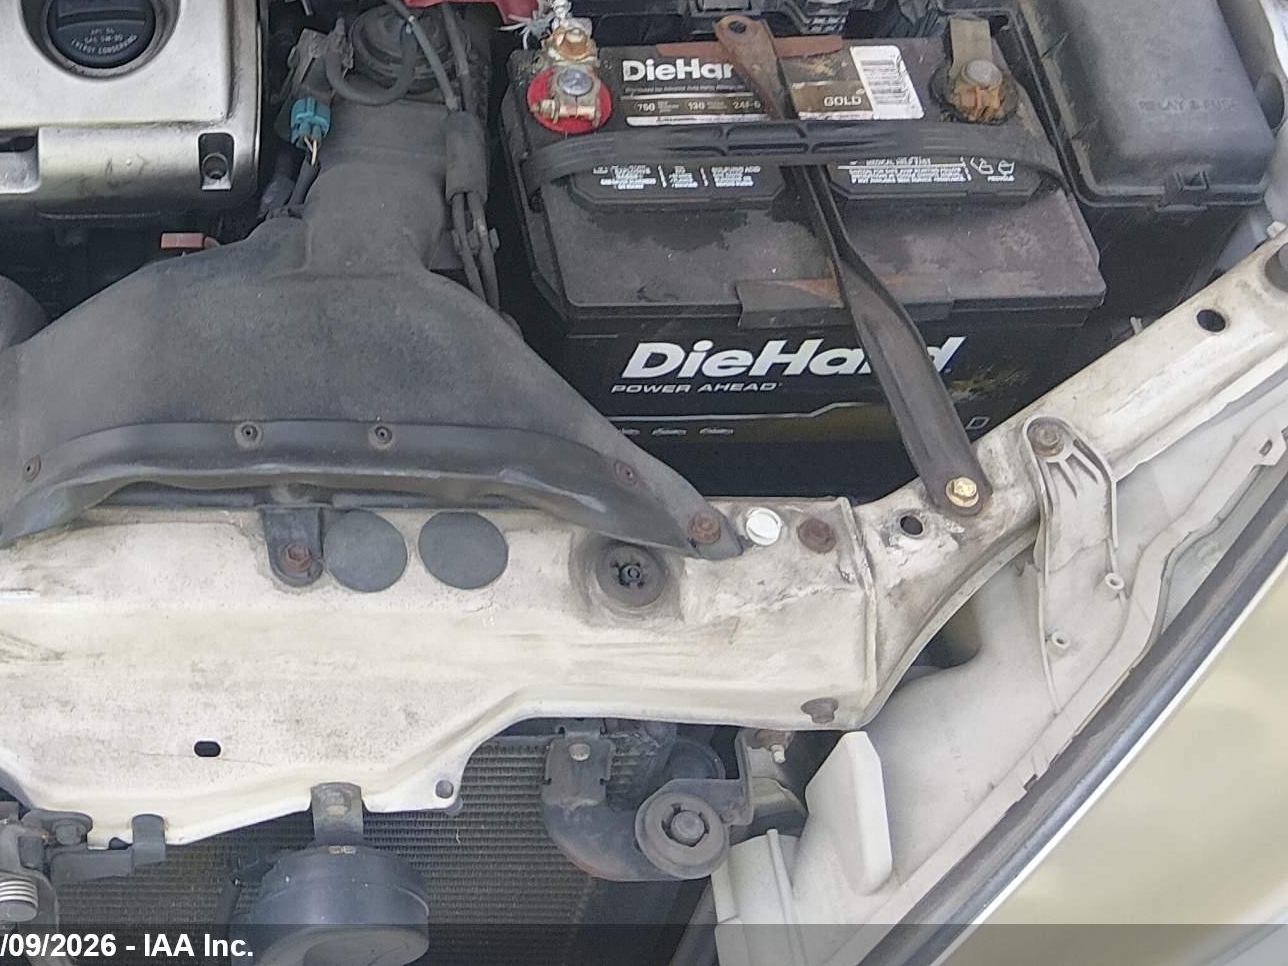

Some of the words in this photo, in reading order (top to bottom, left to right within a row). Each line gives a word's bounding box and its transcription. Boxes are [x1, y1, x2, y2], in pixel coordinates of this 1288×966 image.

[622, 58, 734, 81] DieHar
[823, 96, 862, 107] GOLD
[611, 383, 691, 394] POWER
[697, 382, 779, 393] AHEAD
